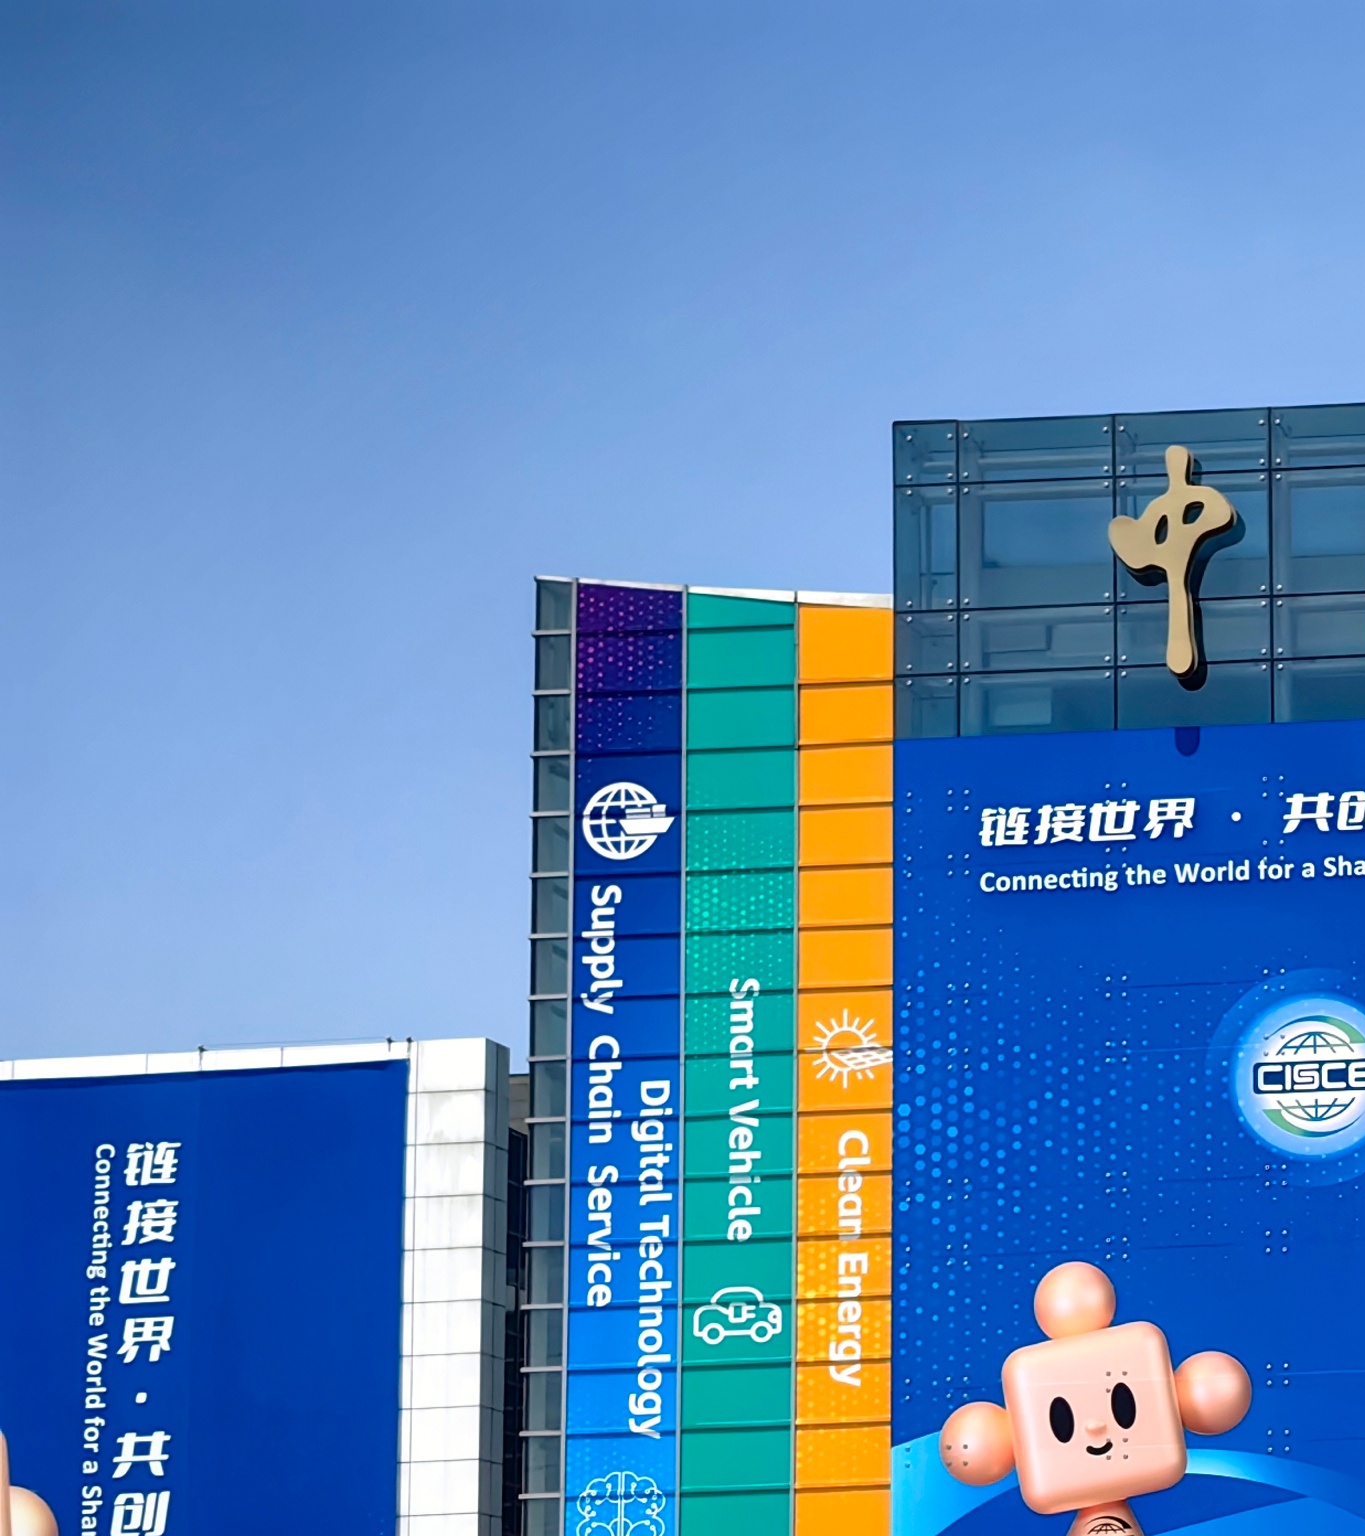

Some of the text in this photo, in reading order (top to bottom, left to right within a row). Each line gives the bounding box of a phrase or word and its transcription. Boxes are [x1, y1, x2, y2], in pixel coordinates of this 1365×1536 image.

[979, 867, 1119, 893] Connecting
[1125, 863, 1167, 886] the
[1173, 859, 1250, 884] World
[1257, 856, 1295, 880] for
[1301, 862, 1315, 878] a
[580, 884, 623, 1307] Supply Chain Service
[726, 978, 762, 1241] Smart Vehicle
[86, 1143, 116, 1279] Connecting
[628, 1080, 673, 1439] Digital Technology
[830, 1129, 870, 1388] Clean Energy
[88, 1285, 111, 1327] the
[85, 1333, 108, 1409] World
[82, 1460, 99, 1474] a
[83, 1416, 106, 1453] for
